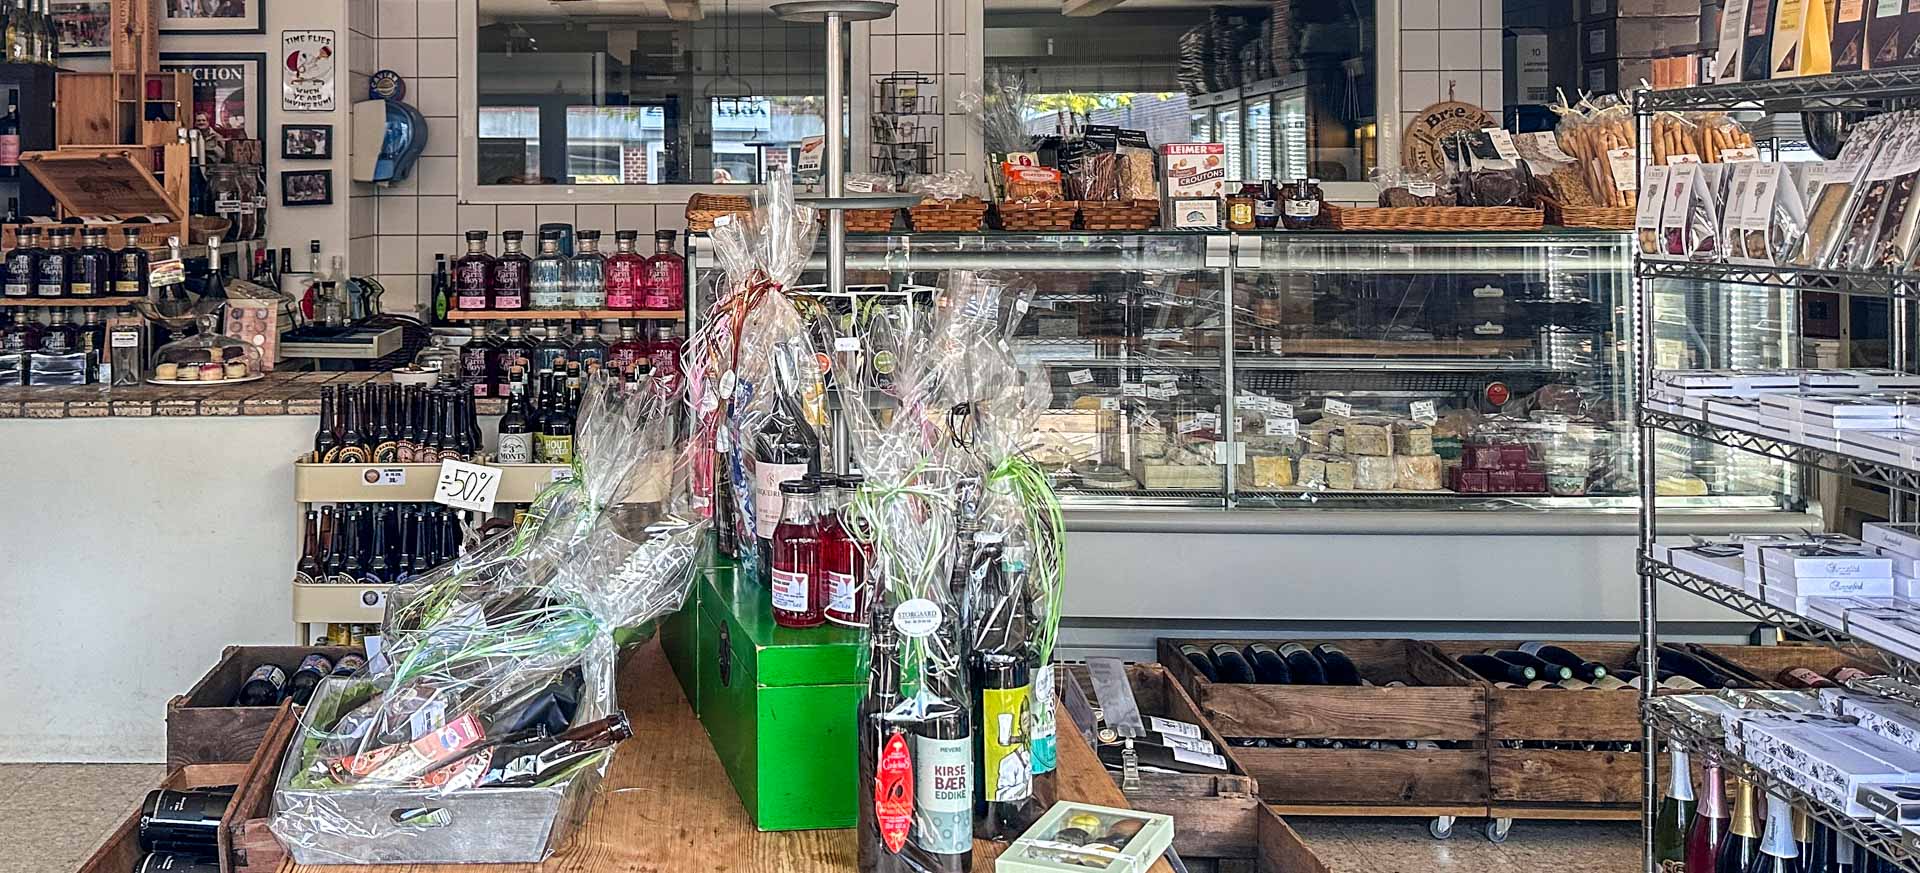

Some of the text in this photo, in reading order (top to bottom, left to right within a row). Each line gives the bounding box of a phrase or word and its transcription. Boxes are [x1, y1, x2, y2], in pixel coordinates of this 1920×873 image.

[285, 34, 331, 45] TIME FLIES
[1424, 107, 1466, 129] Brie
[1170, 145, 1208, 154] LEIMER
[1180, 169, 1223, 185] CROUTONS
[545, 440, 569, 449] HOUT
[935, 765, 966, 776] KIRSE
[935, 777, 966, 790] BÆR
[935, 790, 966, 800] EDDIKE
